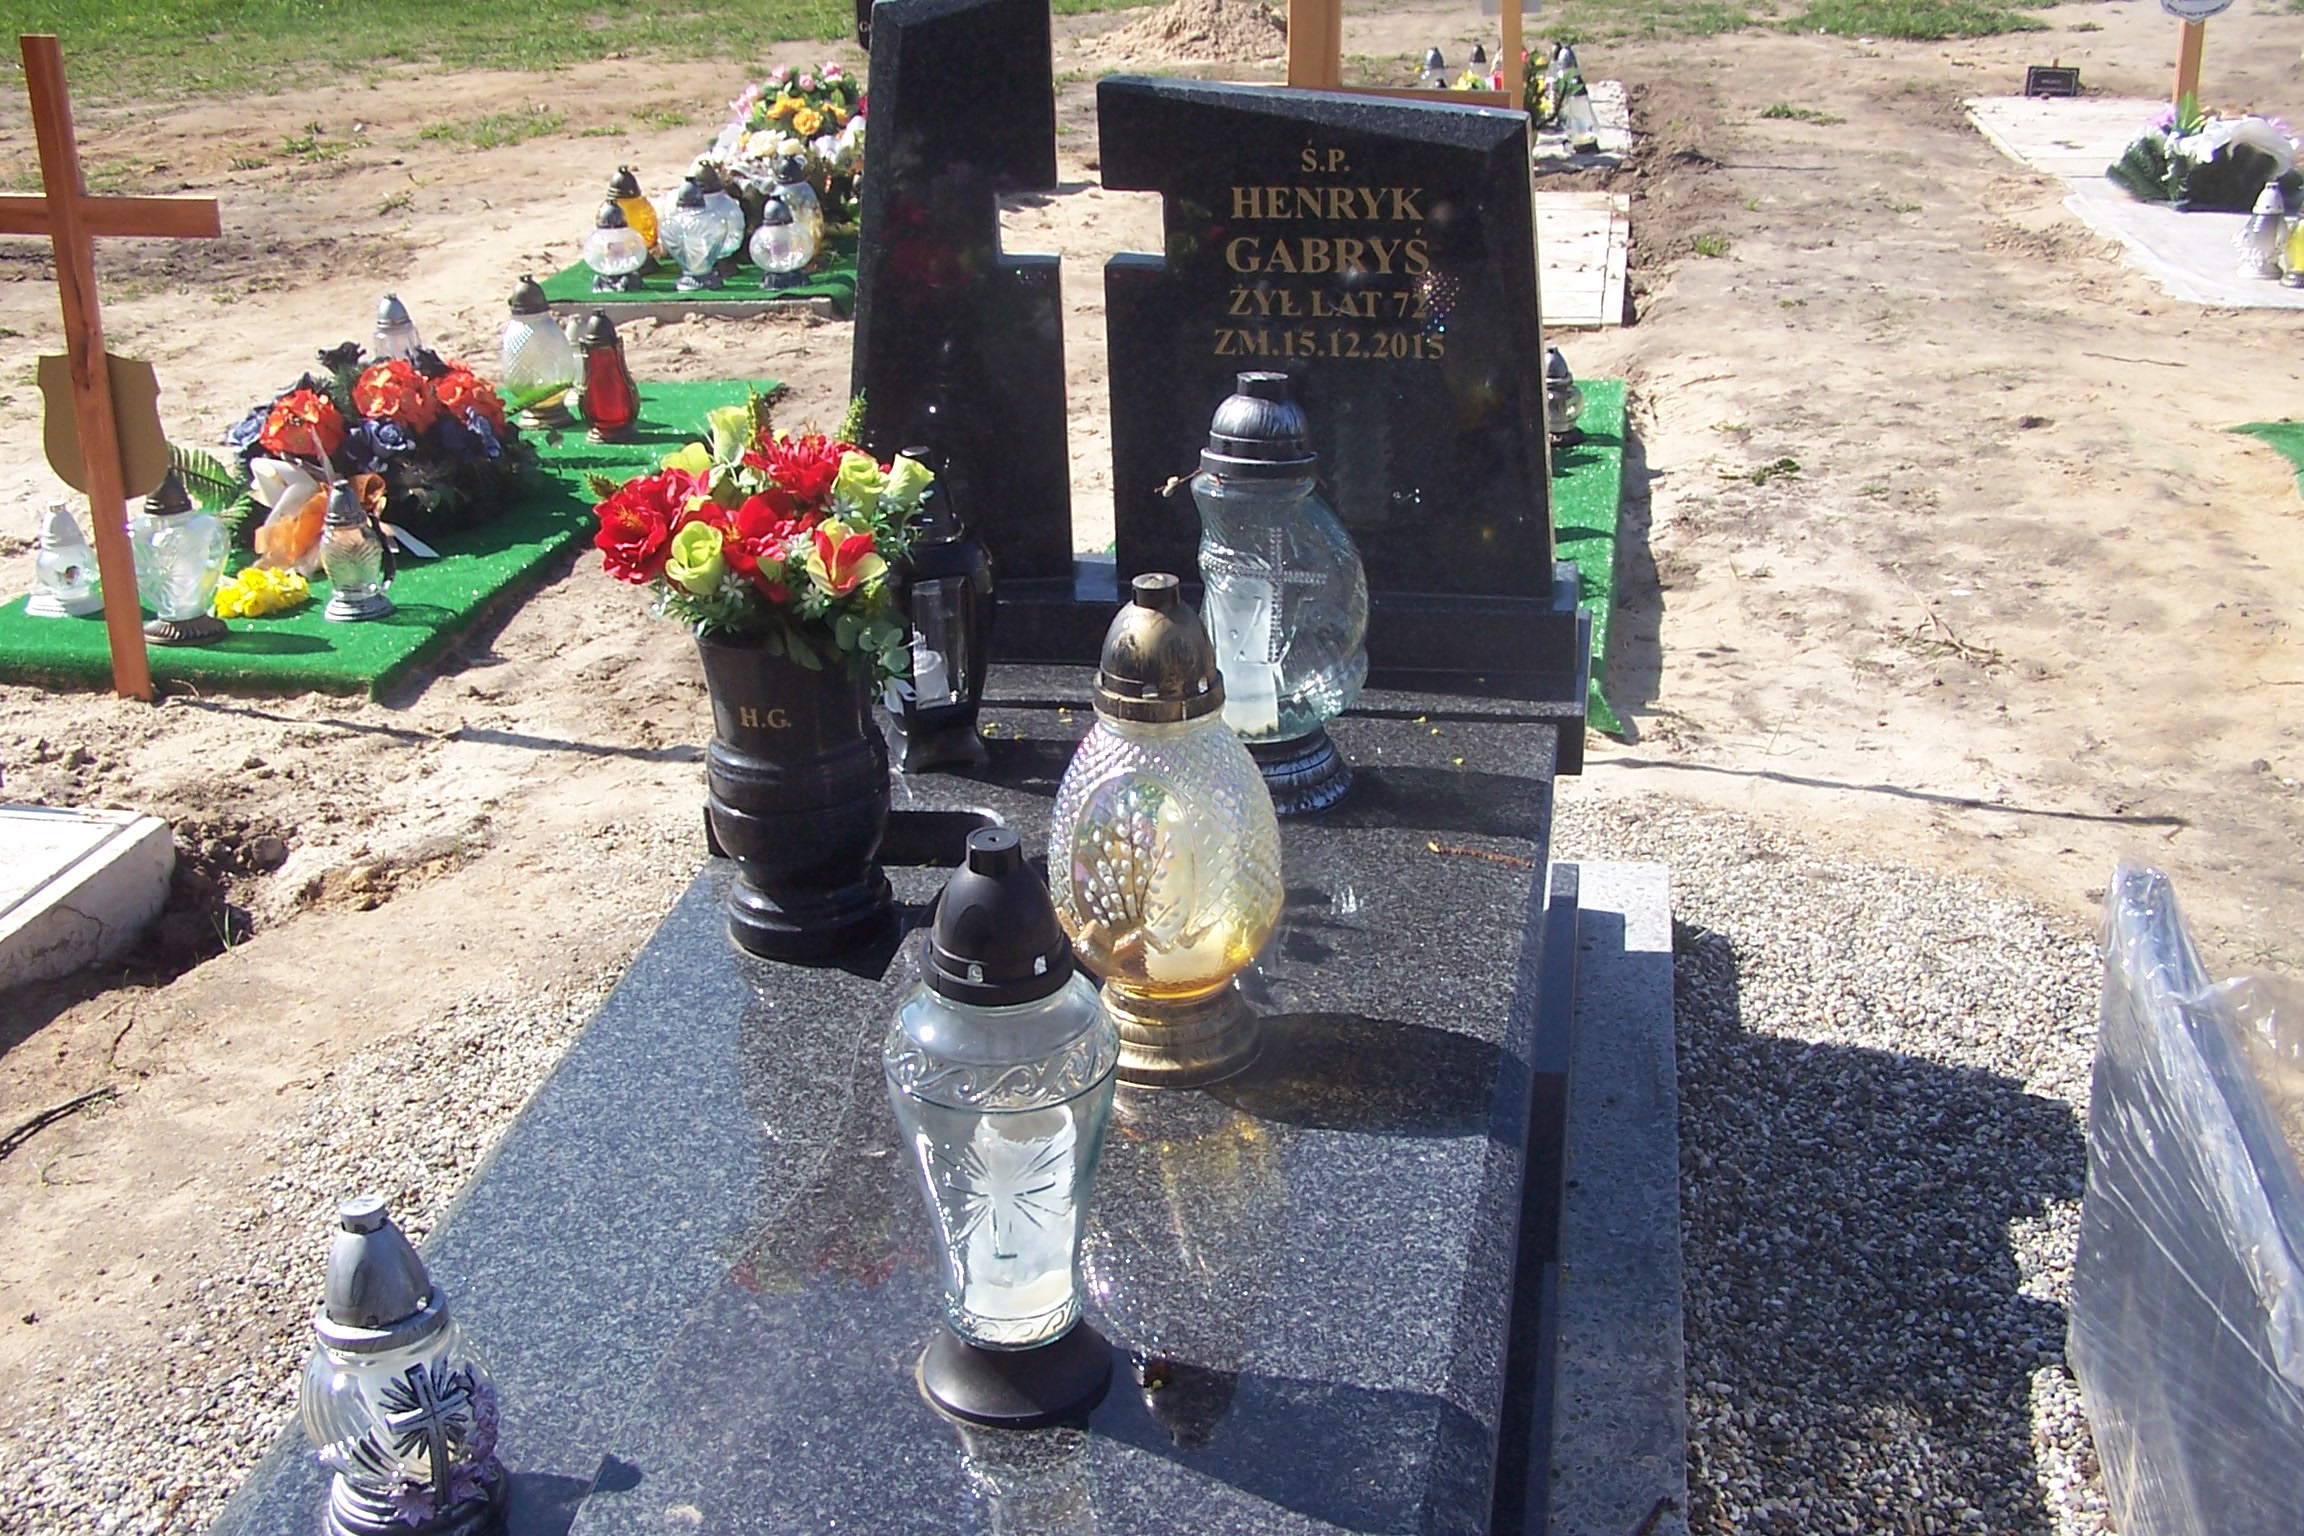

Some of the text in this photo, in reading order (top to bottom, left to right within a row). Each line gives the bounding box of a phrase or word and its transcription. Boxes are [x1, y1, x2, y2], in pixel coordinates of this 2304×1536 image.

[1301, 139, 1350, 172] Ś.P.
[1230, 186, 1424, 220] HENRYK
[1225, 227, 1430, 275] GABRYŚ
[1228, 283, 1429, 319] ŻYŁ LAT 72
[739, 706, 792, 729] H.G.
